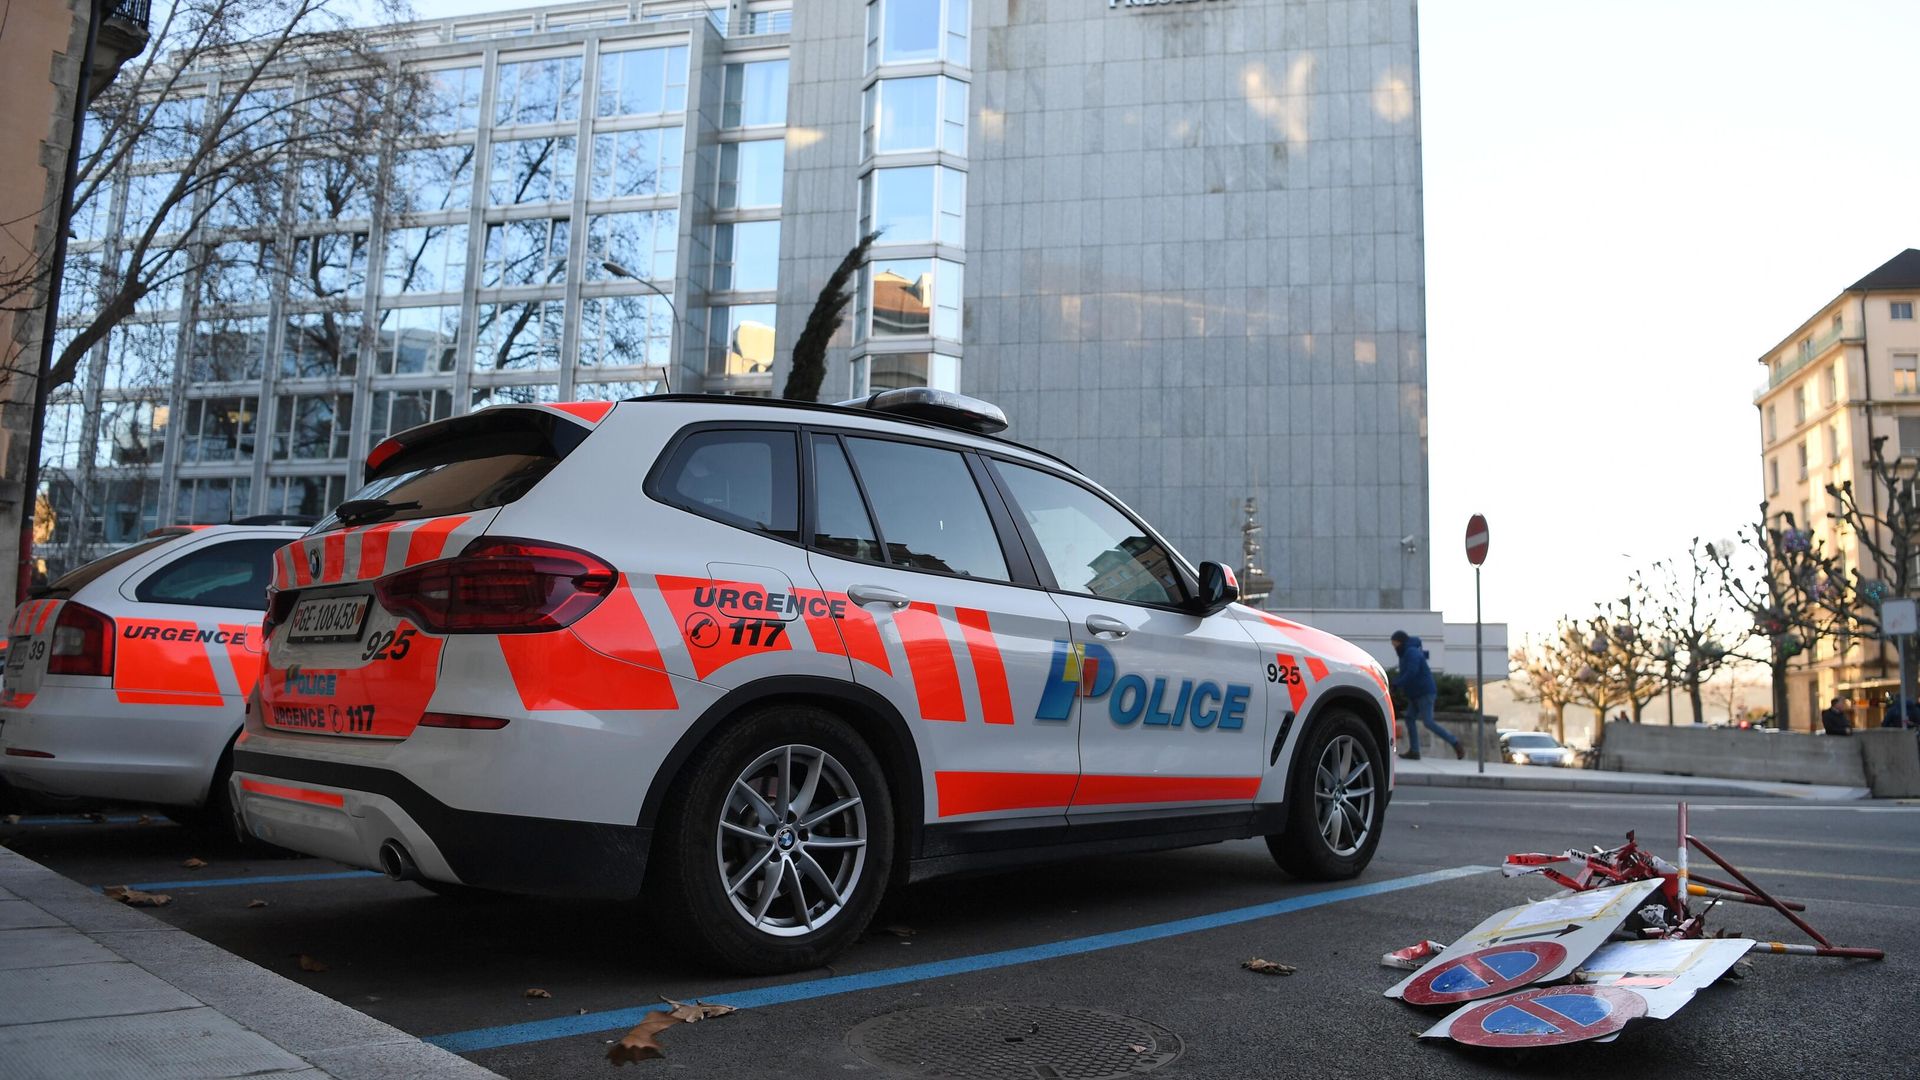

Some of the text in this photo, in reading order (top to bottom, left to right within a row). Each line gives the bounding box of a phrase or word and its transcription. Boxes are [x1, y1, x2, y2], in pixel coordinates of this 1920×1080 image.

[693, 586, 847, 620] URGENCE
[123, 625, 248, 645] URGENCE
[361, 629, 417, 661] 925
[729, 617, 786, 647] 117
[284, 664, 337, 697] POLICE
[1034, 639, 1254, 731] POLICE
[1266, 662, 1302, 686] 925
[273, 704, 375, 732] URGENCE 117
